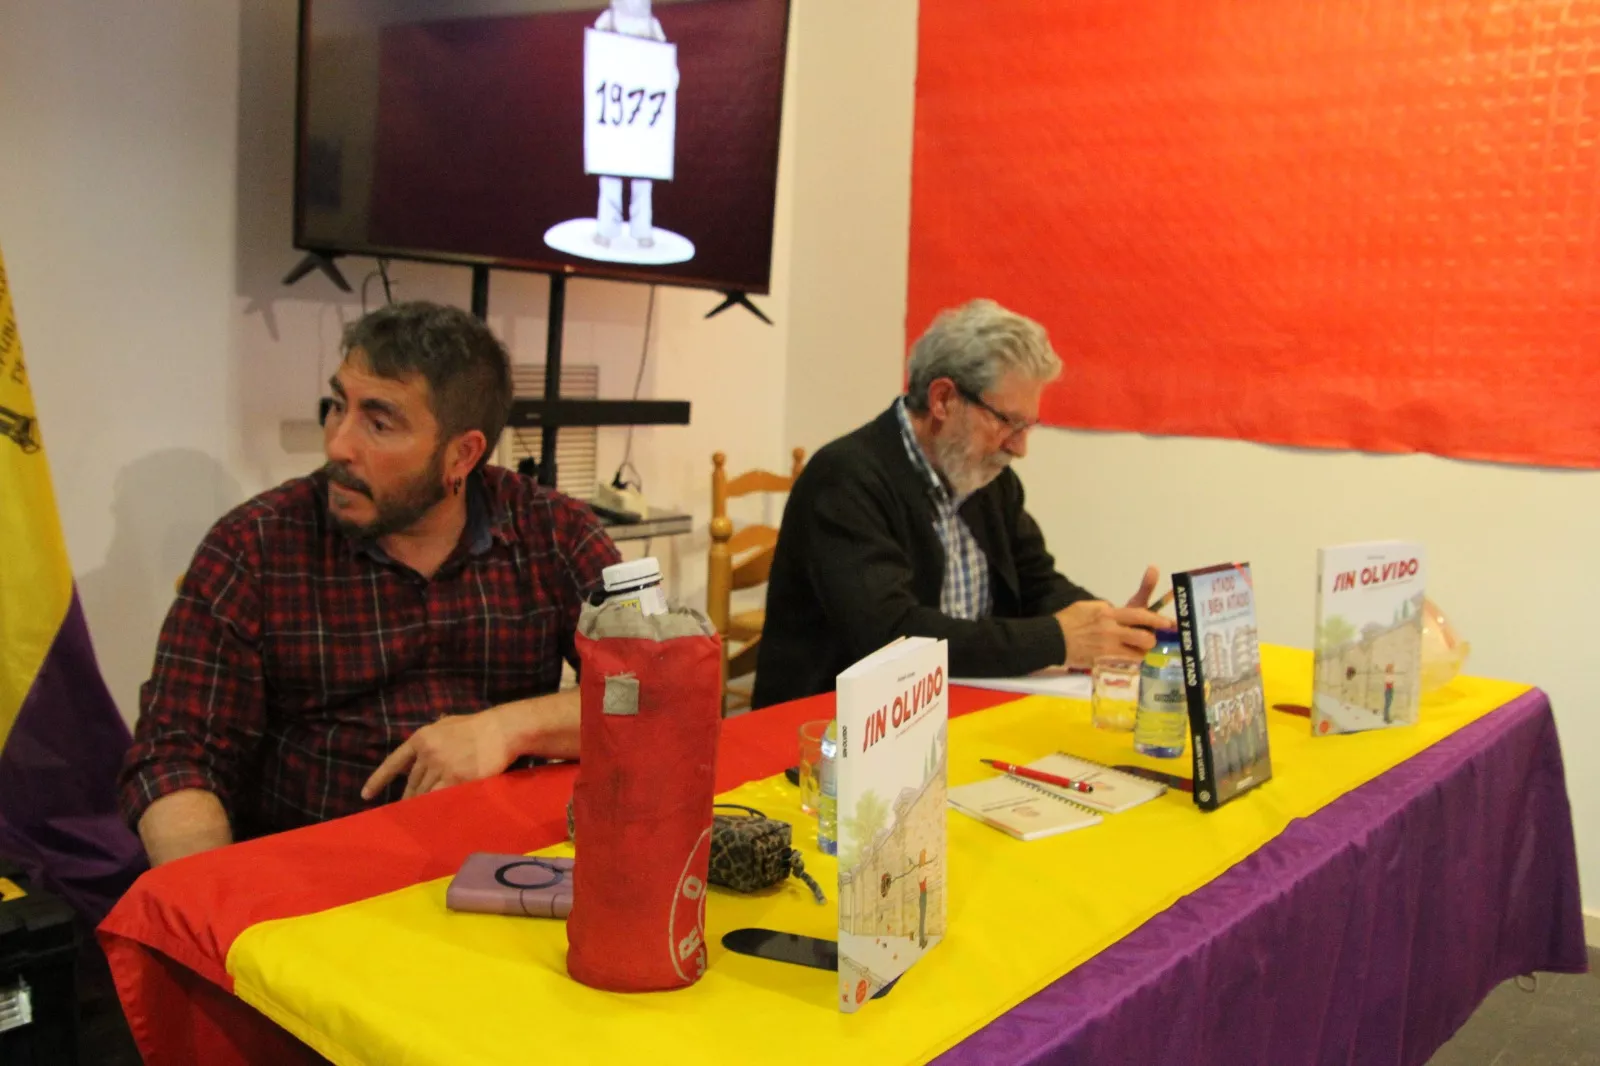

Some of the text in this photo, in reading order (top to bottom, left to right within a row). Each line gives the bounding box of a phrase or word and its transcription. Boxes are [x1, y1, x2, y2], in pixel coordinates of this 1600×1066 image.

[596, 80, 667, 127] 1977
[1332, 569, 1357, 593] SIN
[1361, 557, 1419, 586] OLVIDO
[1177, 585, 1198, 687] ATADO Y BIEN ATADO
[862, 703, 887, 754] SIN
[892, 665, 943, 729] OLVIDO
